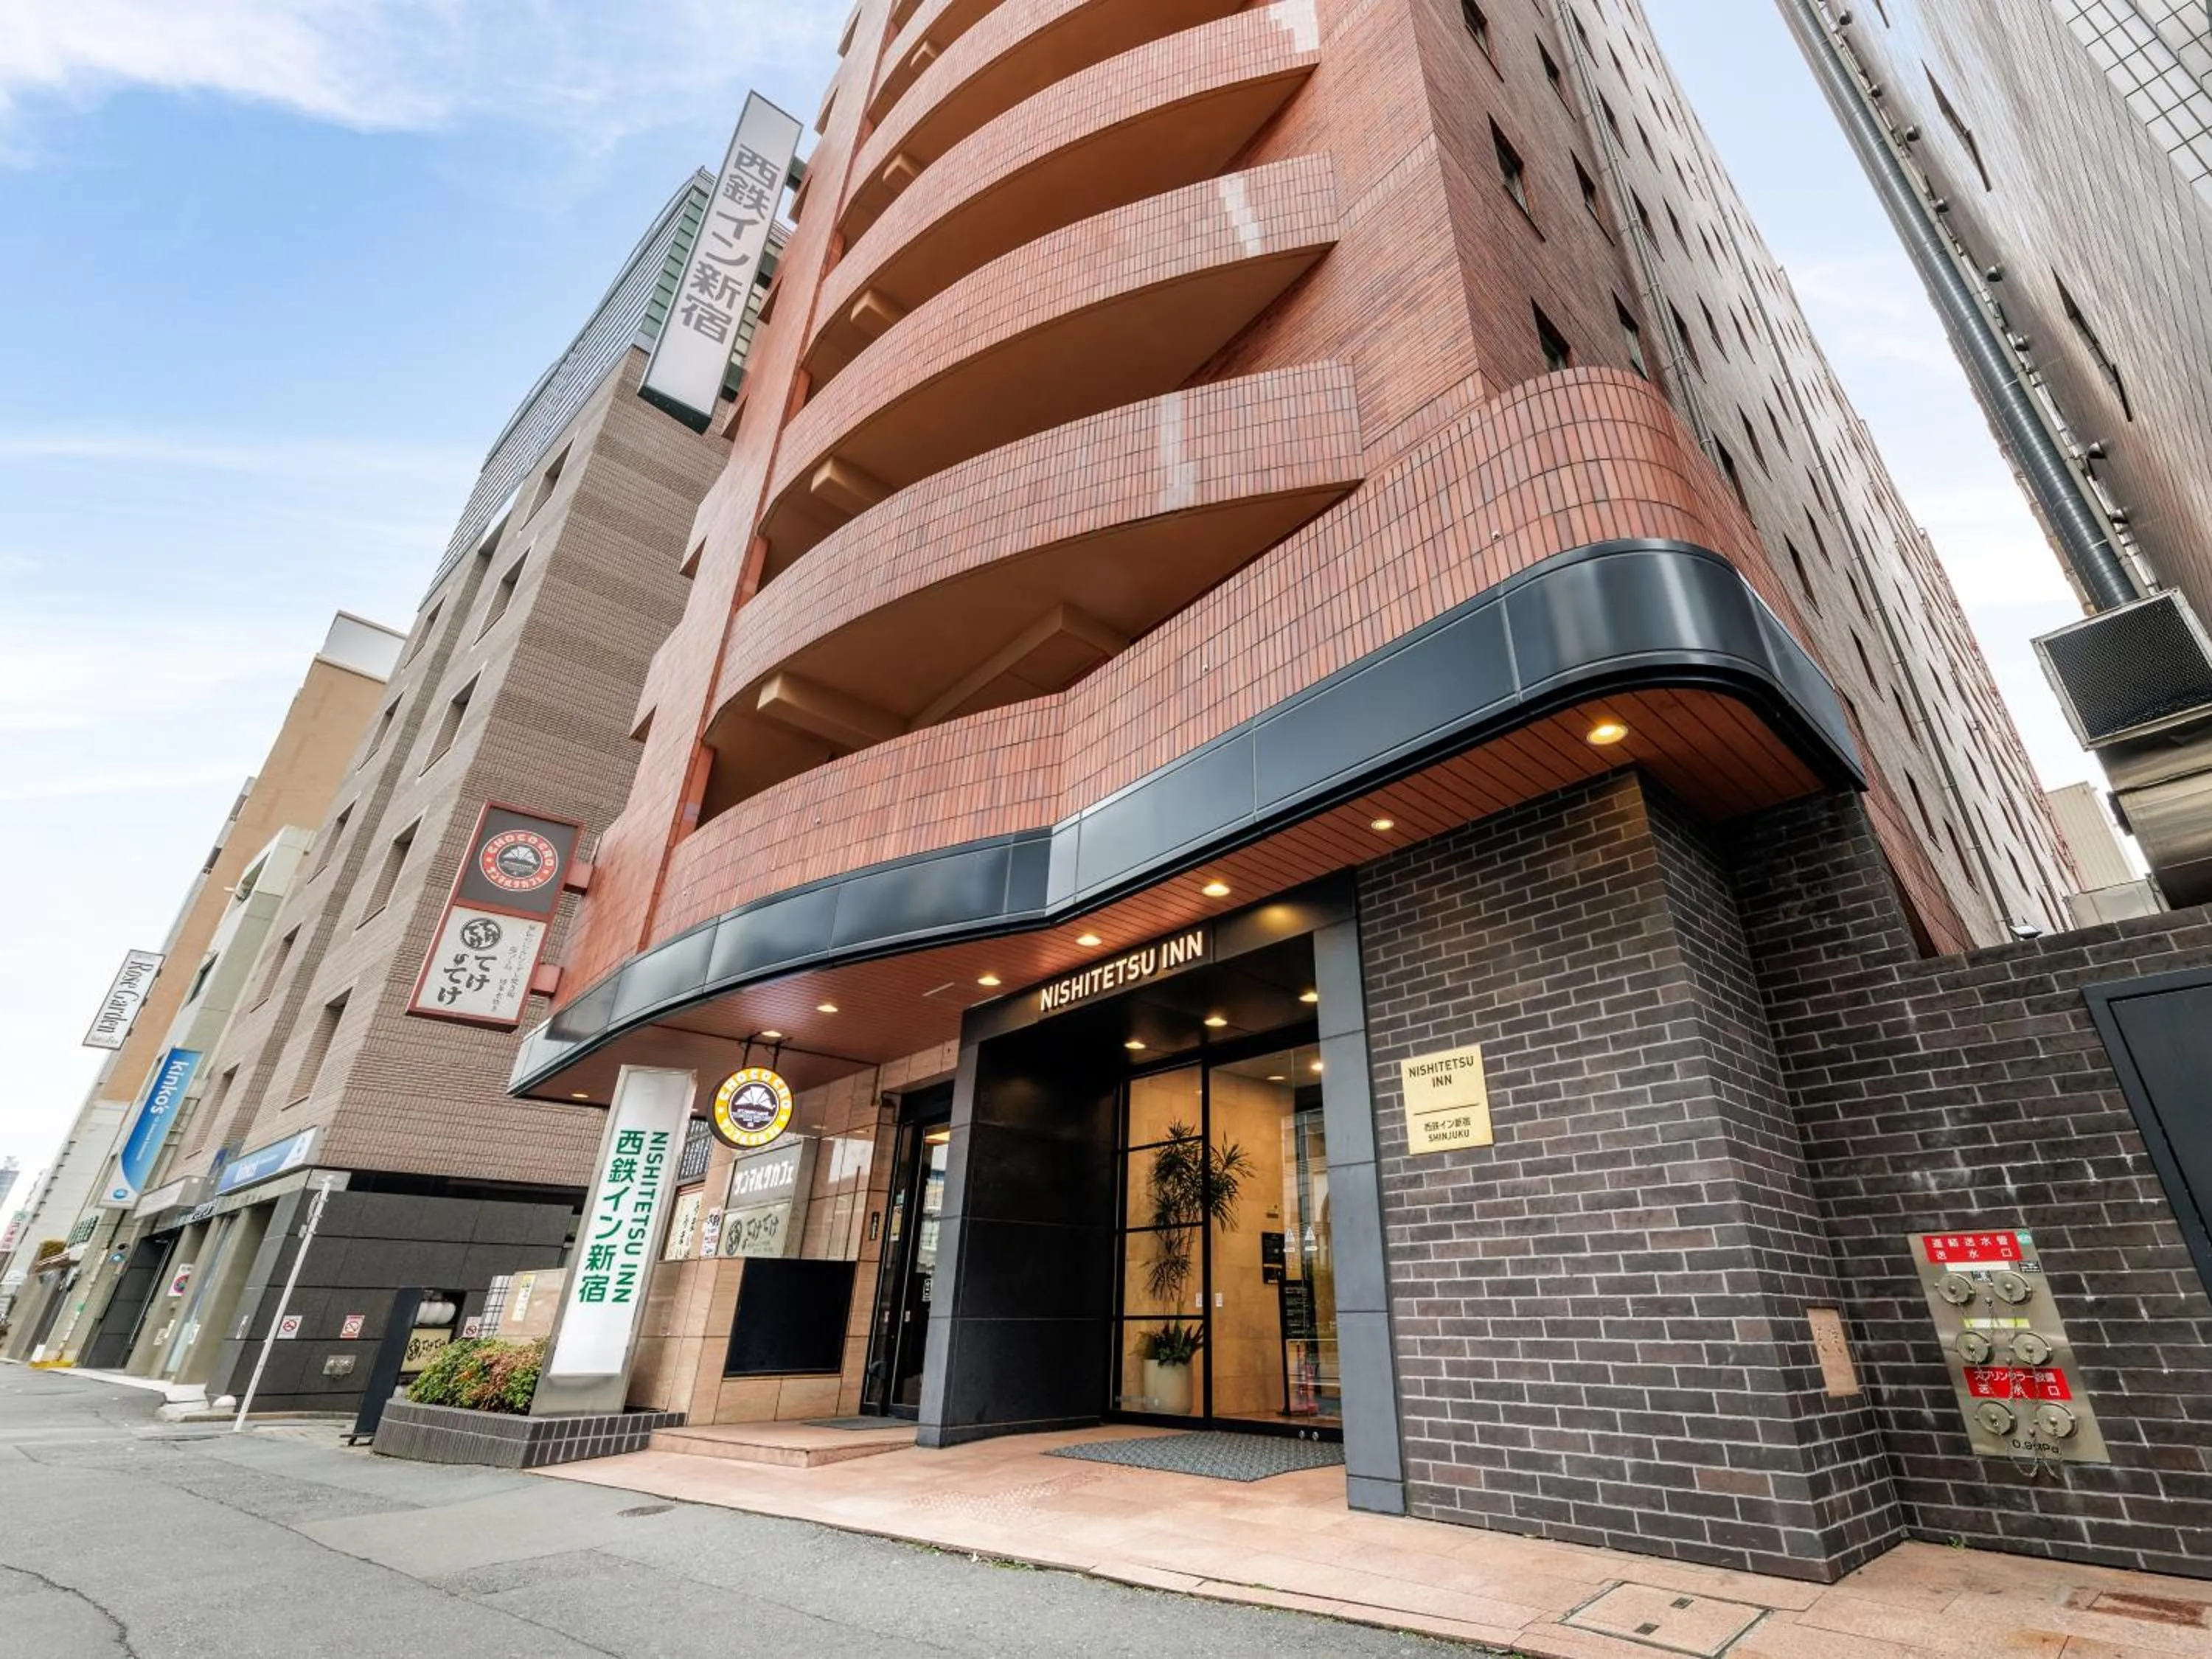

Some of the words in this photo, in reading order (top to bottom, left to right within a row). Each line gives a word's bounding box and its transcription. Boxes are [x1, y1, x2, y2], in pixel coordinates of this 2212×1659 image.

[681, 143, 780, 345] 西鉄イン新宿
[119, 961, 153, 989] Rose
[1040, 948, 1155, 1011] NISHITETSU
[1162, 931, 1203, 968] INN
[97, 990, 139, 1033] Garden
[1409, 1056, 1475, 1078] NISHITETSU
[1432, 1074, 1453, 1088] INN
[1428, 1130, 1470, 1142] SHINJUKU
[625, 1132, 669, 1256] NISHITETSU
[579, 1130, 646, 1303] 西鉄イン新宿
[611, 1264, 638, 1303] INN
